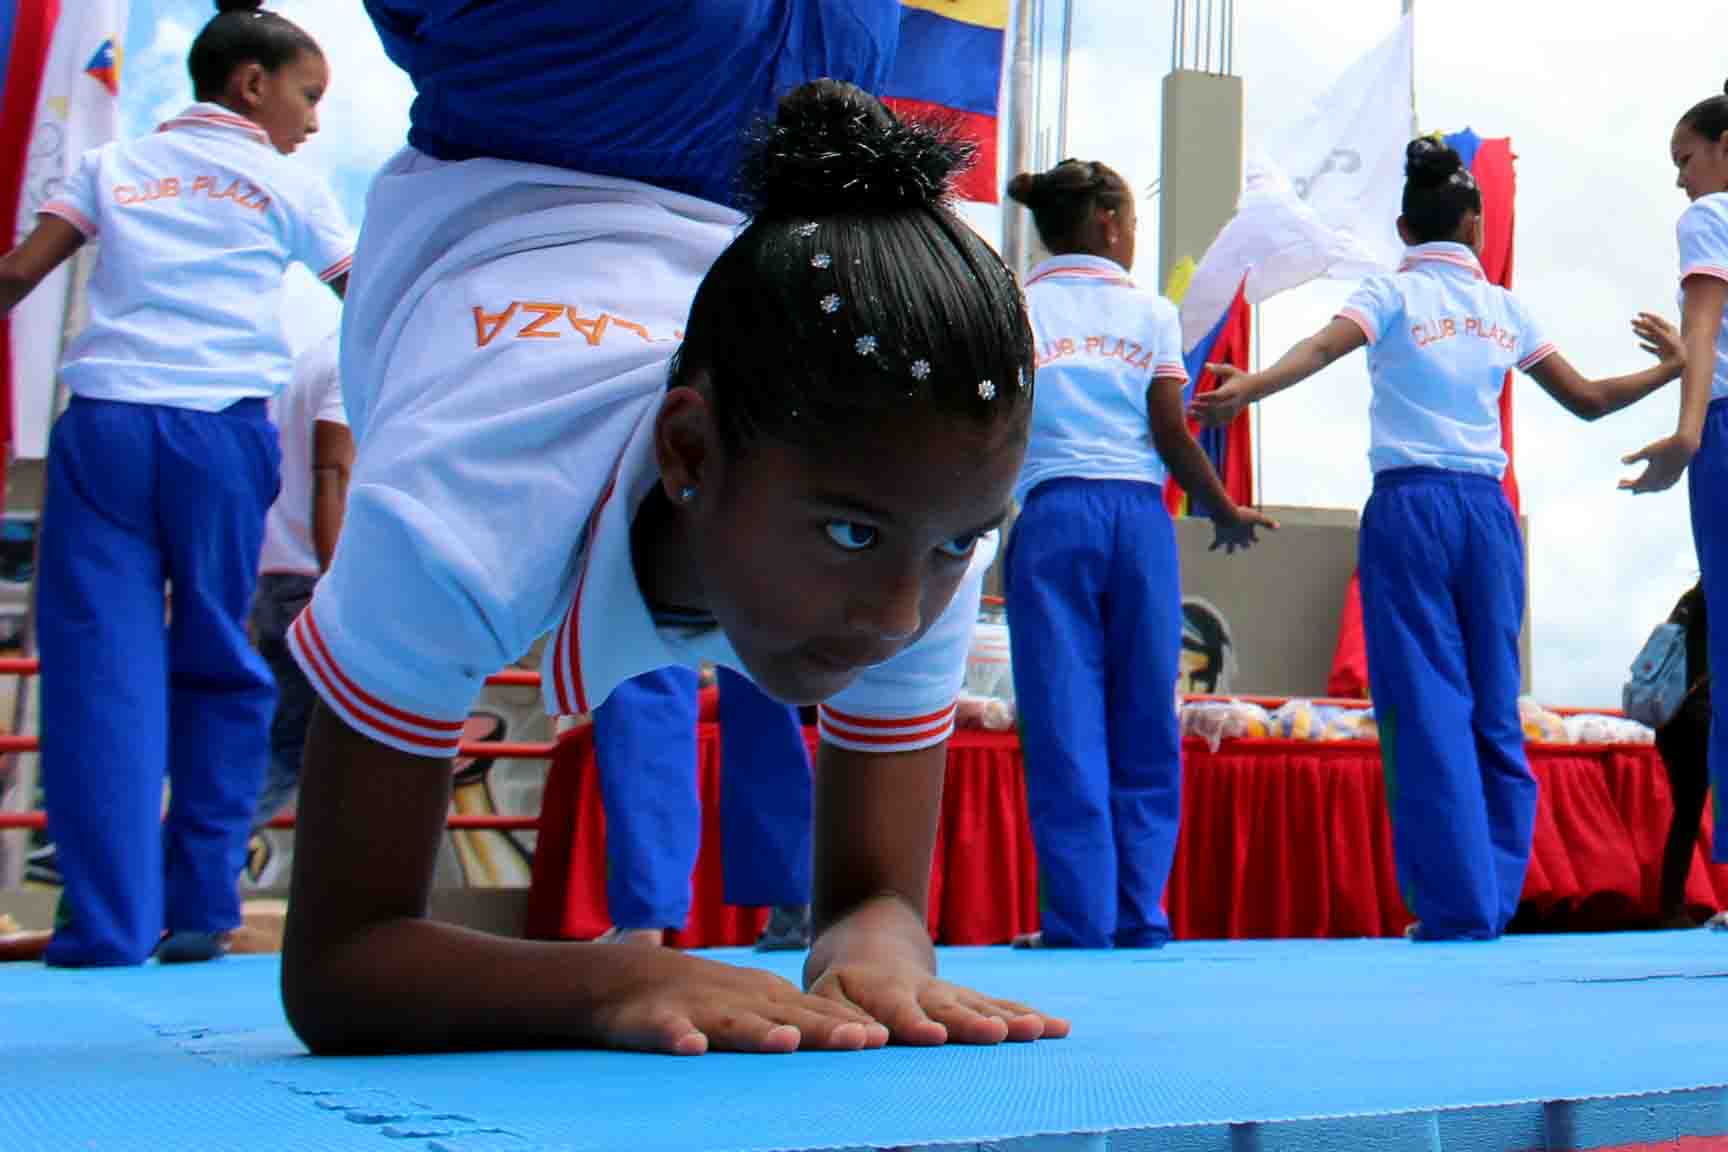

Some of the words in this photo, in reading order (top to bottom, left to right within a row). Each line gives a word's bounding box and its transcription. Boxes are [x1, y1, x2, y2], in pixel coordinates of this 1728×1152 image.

[112, 175, 181, 205] CLUB
[192, 175, 272, 213] PLAZA
[1086, 335, 1152, 370] PLAZA
